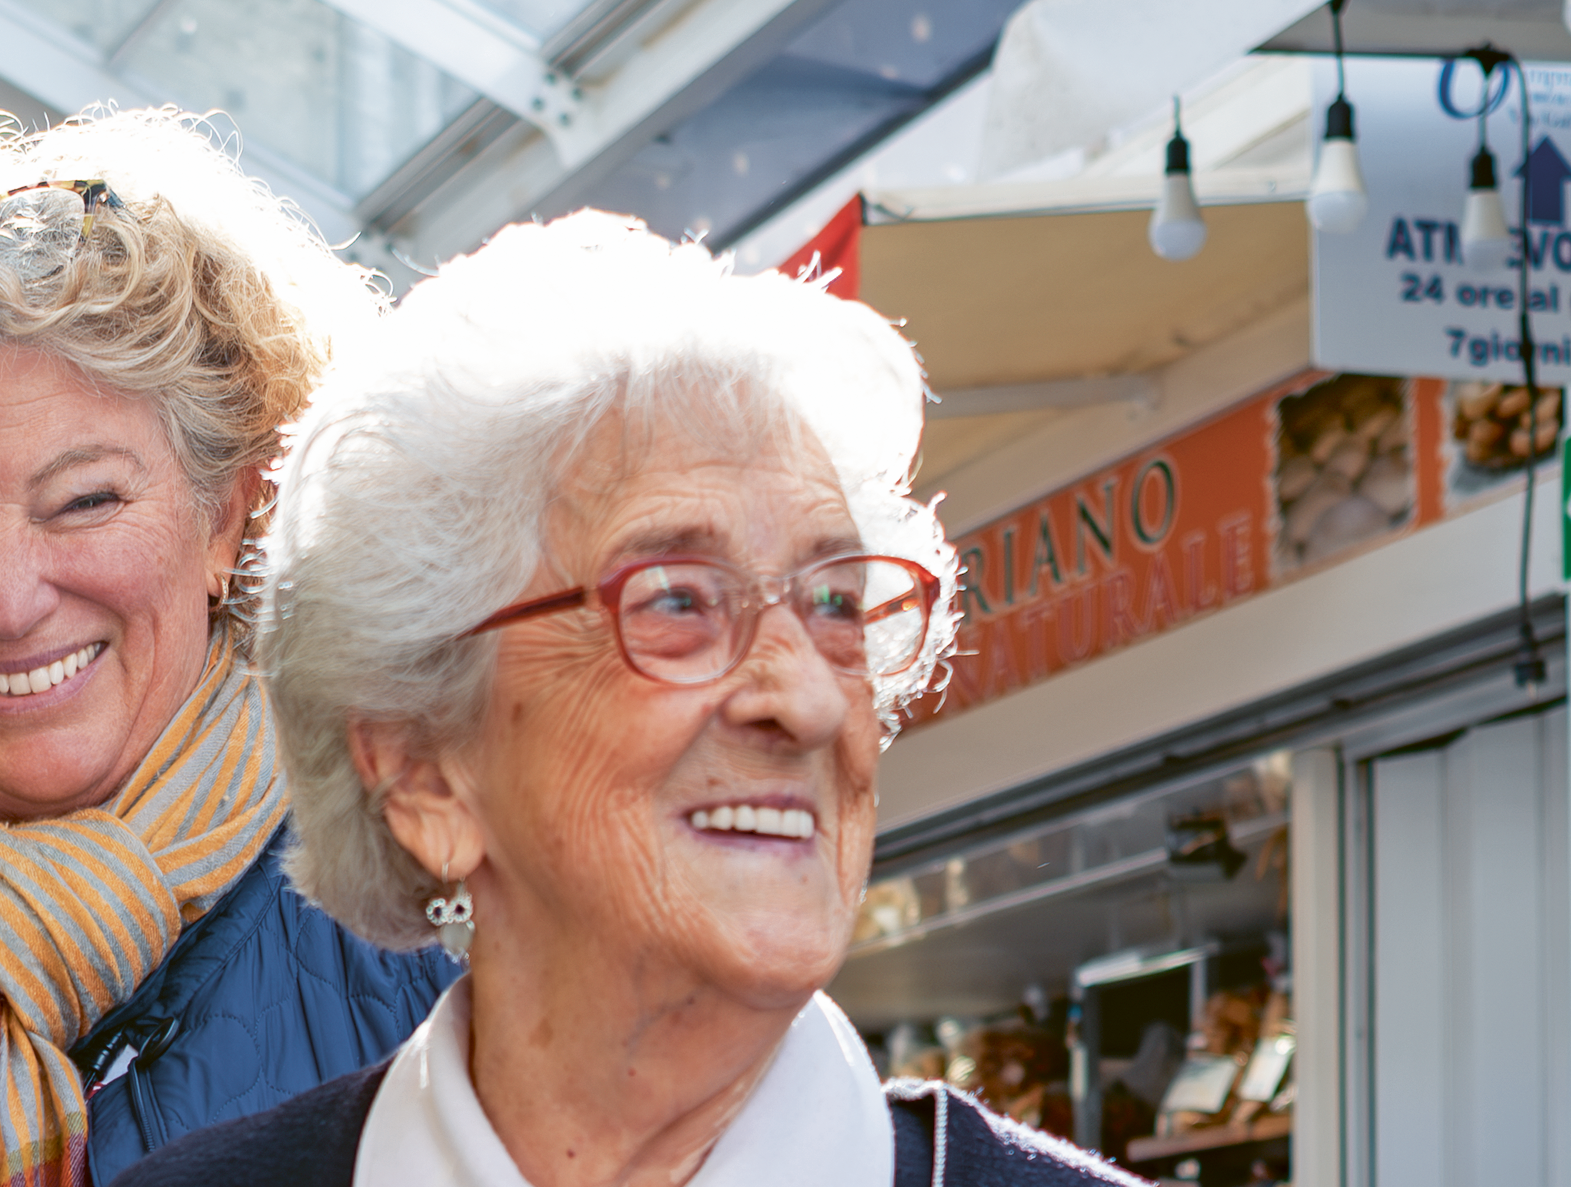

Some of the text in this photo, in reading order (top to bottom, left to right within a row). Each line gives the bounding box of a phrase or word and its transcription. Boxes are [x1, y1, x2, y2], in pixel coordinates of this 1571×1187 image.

[1401, 271, 1559, 312] 24 ore al
